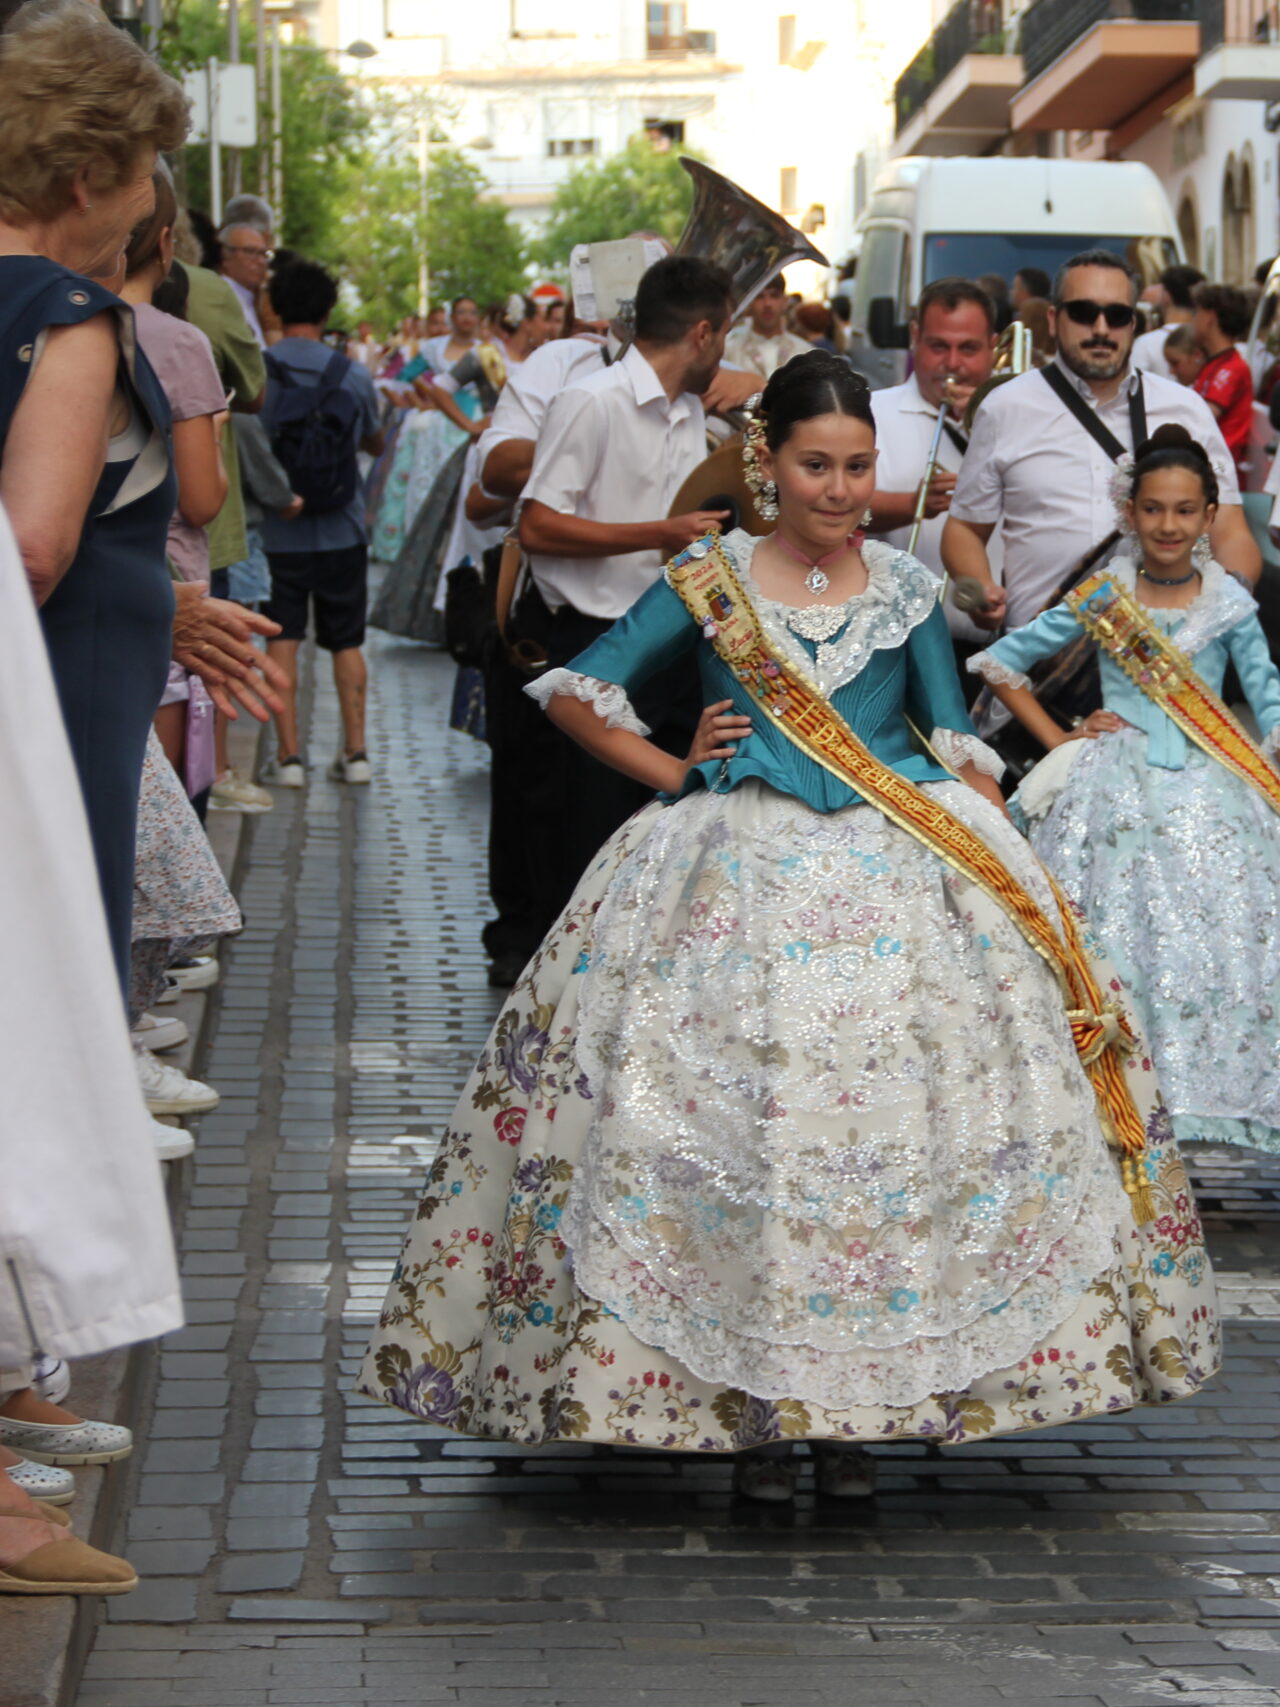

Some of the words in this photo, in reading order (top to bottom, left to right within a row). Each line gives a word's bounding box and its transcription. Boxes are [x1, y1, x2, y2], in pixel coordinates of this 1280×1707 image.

[690, 562, 715, 581] 2024
[810, 718, 863, 768] Dama
[928, 807, 990, 861] Infantil
